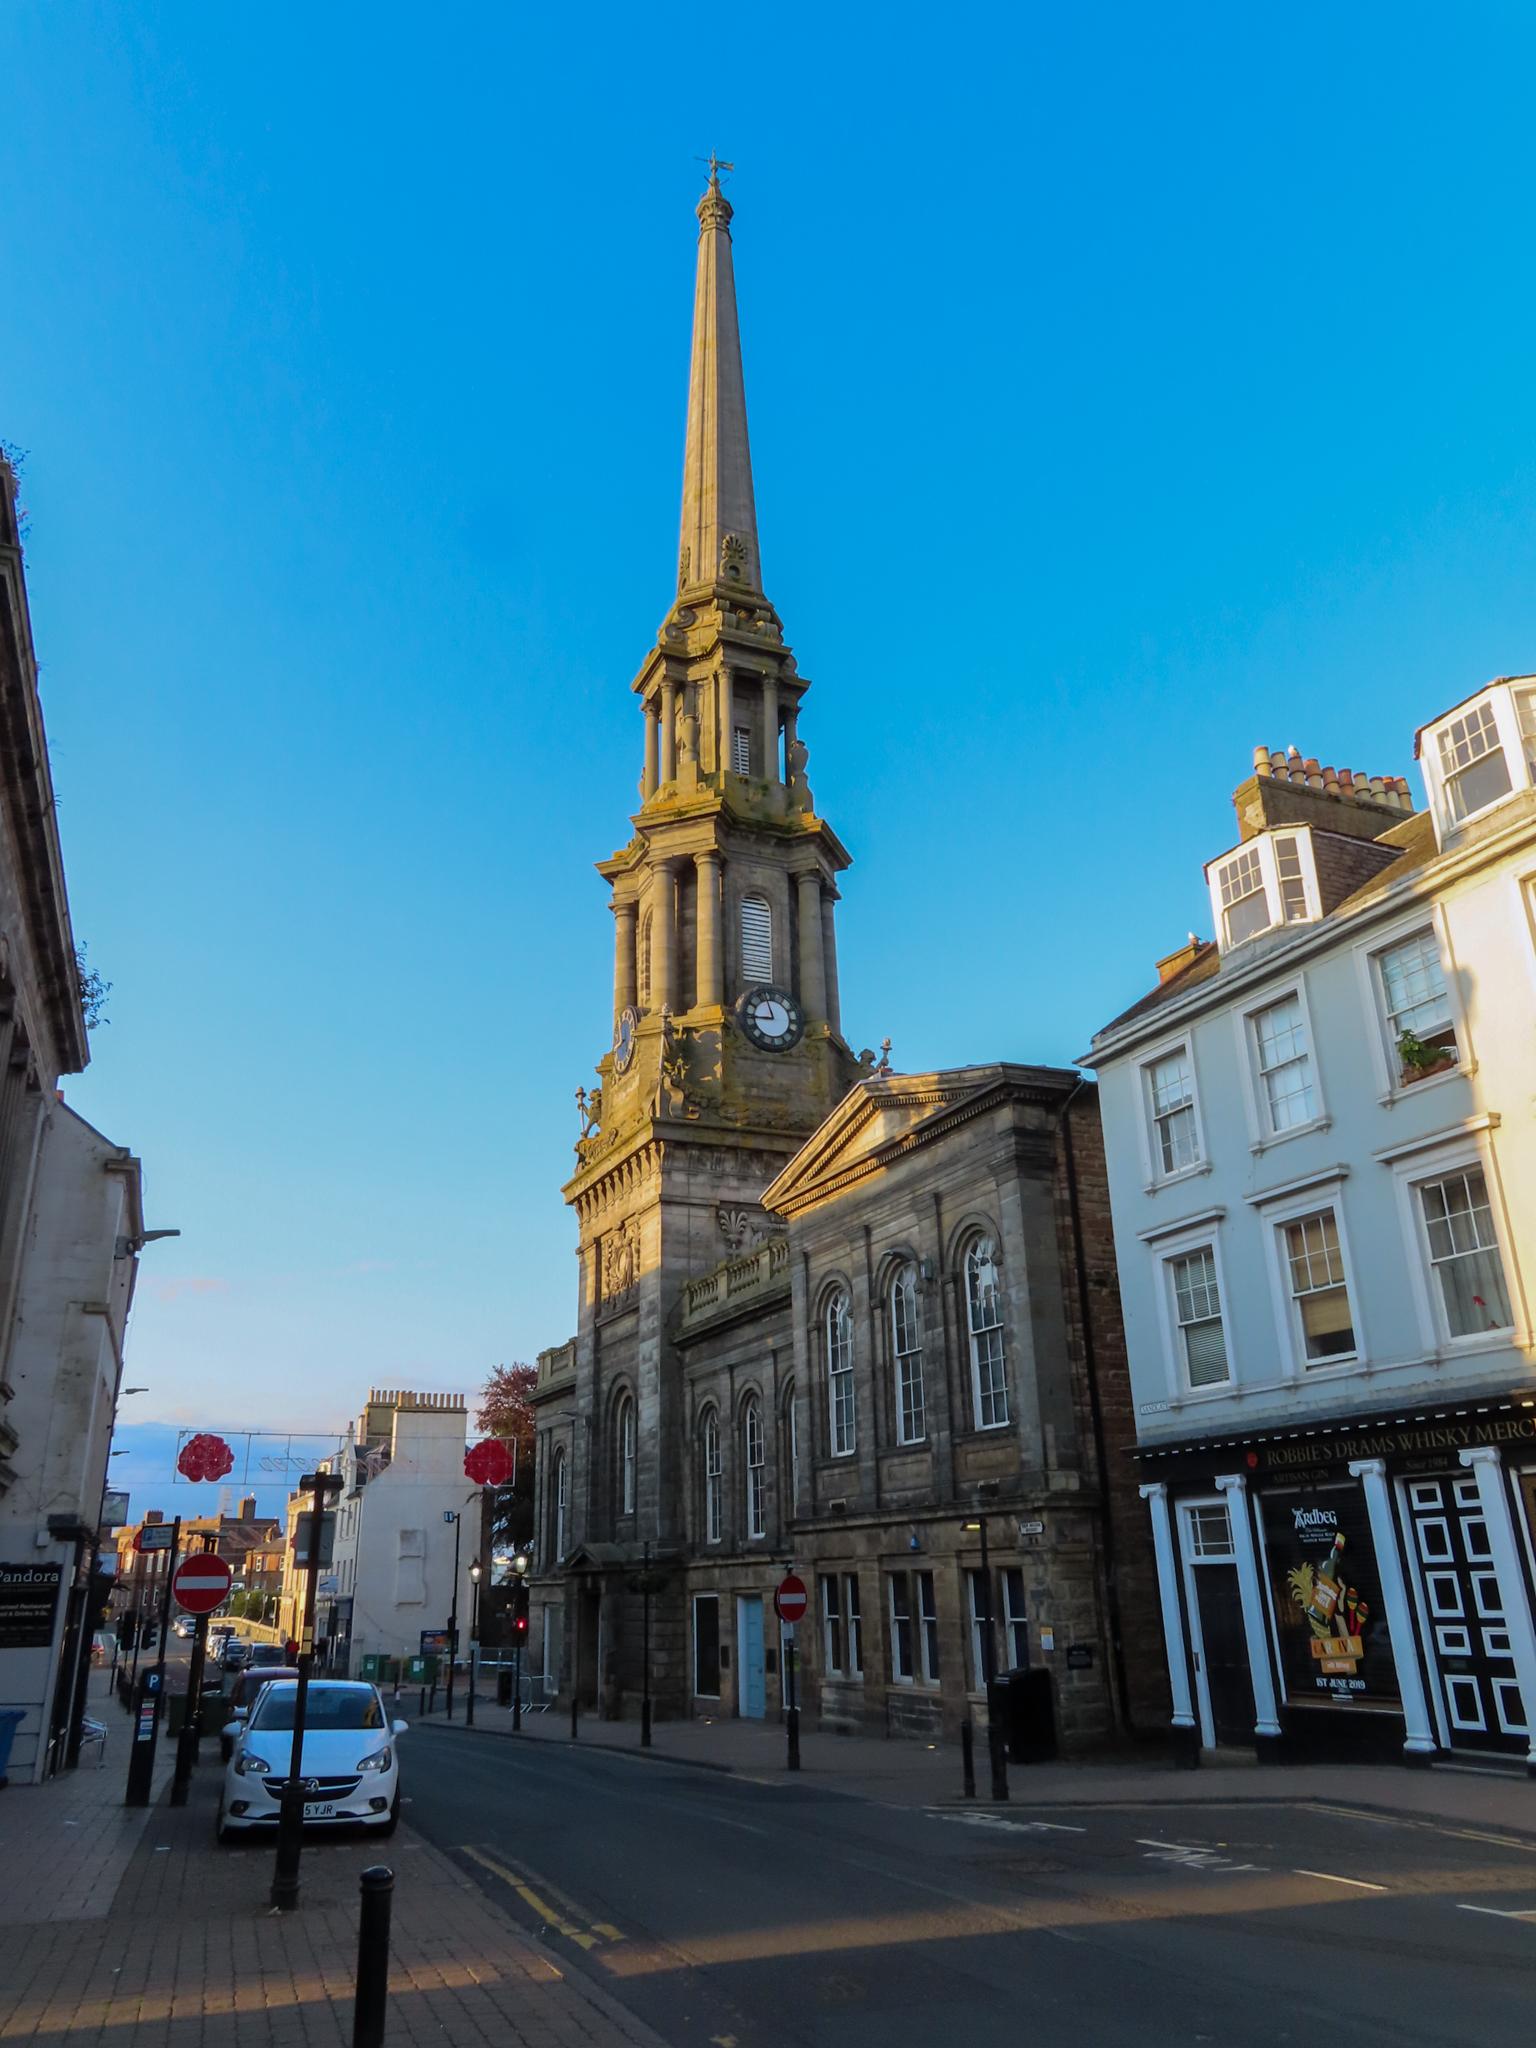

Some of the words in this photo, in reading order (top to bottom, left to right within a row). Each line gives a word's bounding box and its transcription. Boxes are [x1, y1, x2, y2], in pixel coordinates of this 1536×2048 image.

[1266, 1444, 1332, 1465] ROBBIE'S
[1335, 1436, 1396, 1458] DRAMS
[1398, 1425, 1471, 1450] WHISKY
[149, 1674, 159, 1688] P
[1329, 1678, 1348, 1688] JUNE
[1348, 1679, 1366, 1689] 2019
[313, 1804, 333, 1815] YJR
